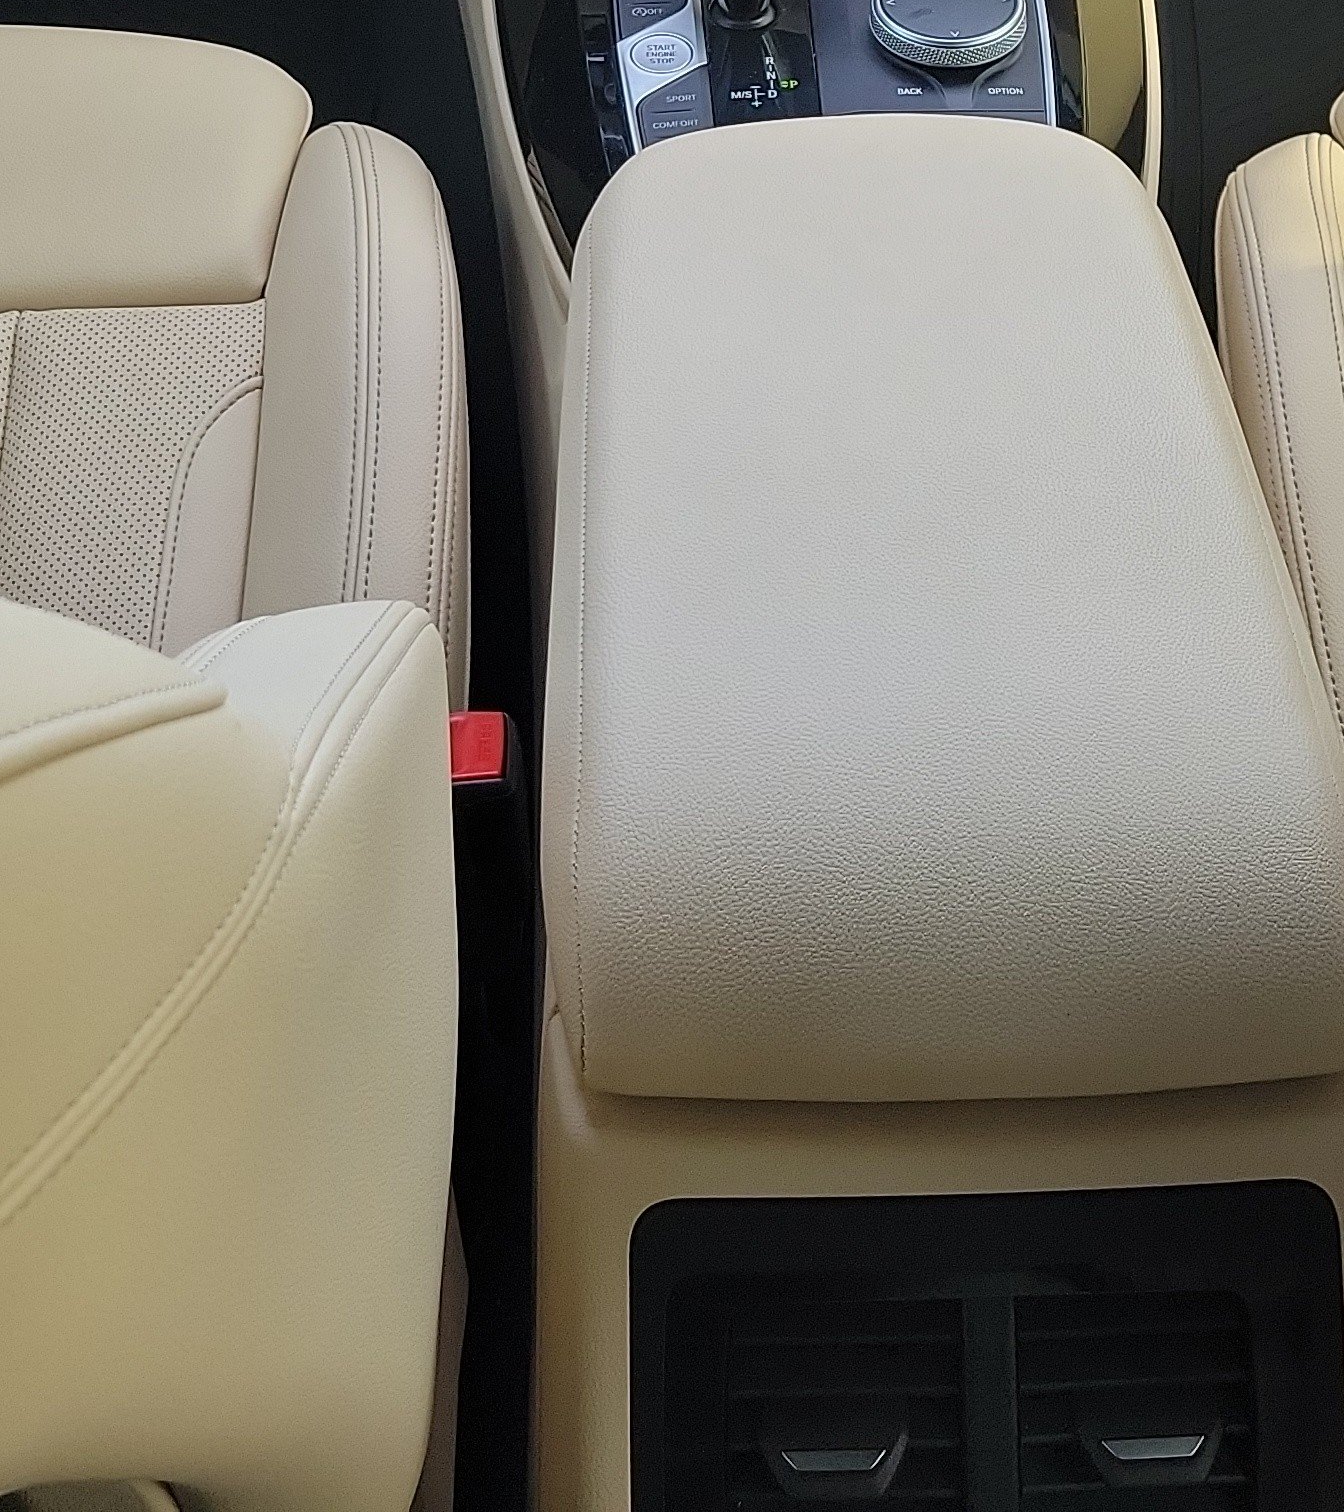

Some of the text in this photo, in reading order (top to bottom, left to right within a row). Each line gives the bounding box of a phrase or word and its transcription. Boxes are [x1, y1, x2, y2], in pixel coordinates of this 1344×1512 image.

[766, 71, 776, 80] N
[730, 90, 753, 99] M/S
[767, 89, 778, 99] D
[897, 87, 923, 95] BACK
[987, 87, 1024, 96] OPTION
[666, 94, 697, 103] SPORT
[652, 119, 698, 129] COMFORT
